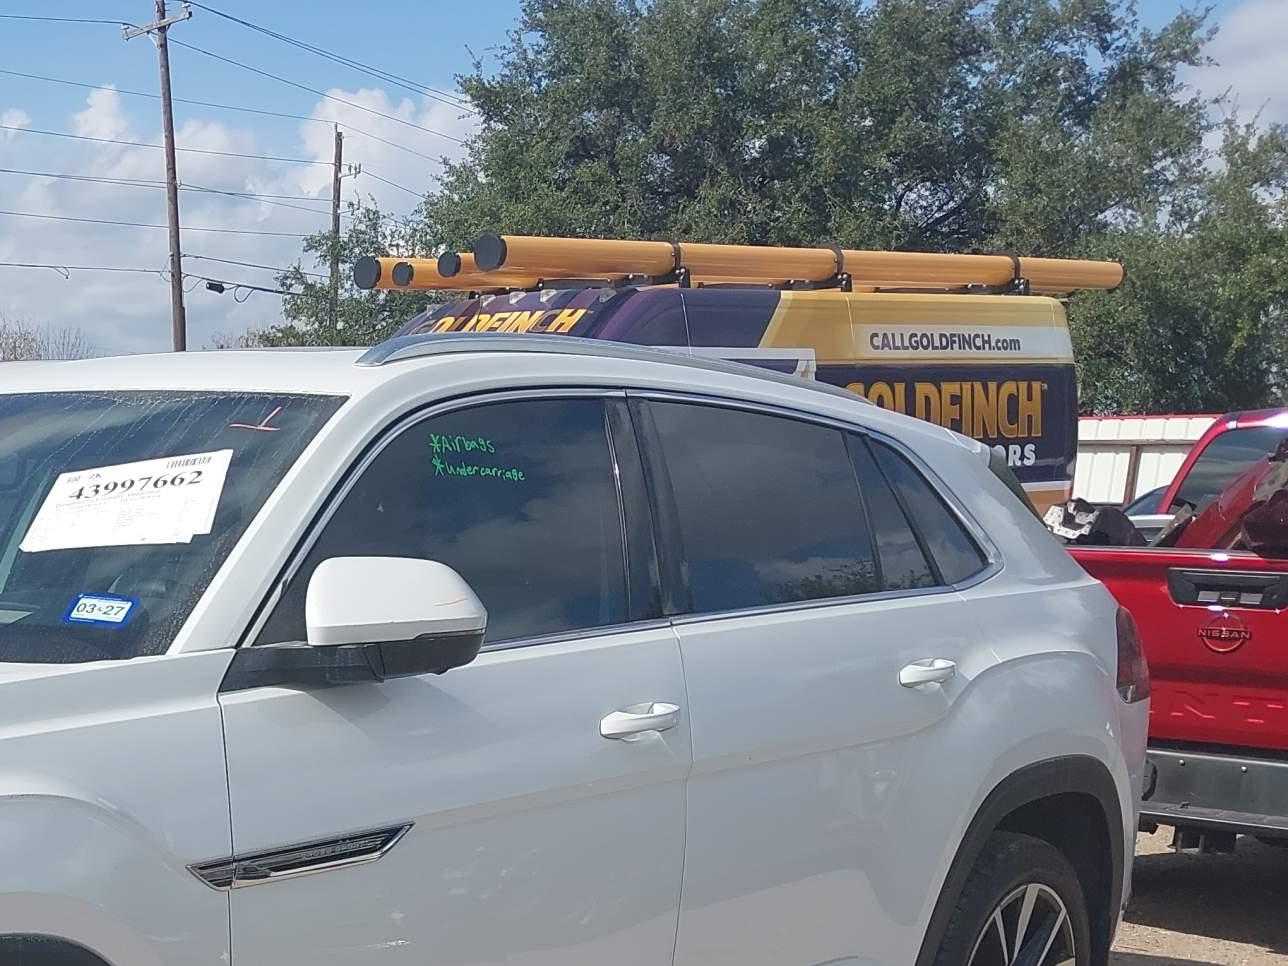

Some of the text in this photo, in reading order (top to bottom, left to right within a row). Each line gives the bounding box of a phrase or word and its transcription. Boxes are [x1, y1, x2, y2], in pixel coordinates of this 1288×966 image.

[869, 332, 1021, 351] CALLGOLDFINCH.com
[845, 381, 1042, 439] LDFINCH
[68, 470, 204, 500] 43997662
[77, 603, 126, 616] 03 27
[1198, 629, 1250, 639] NISSAN
